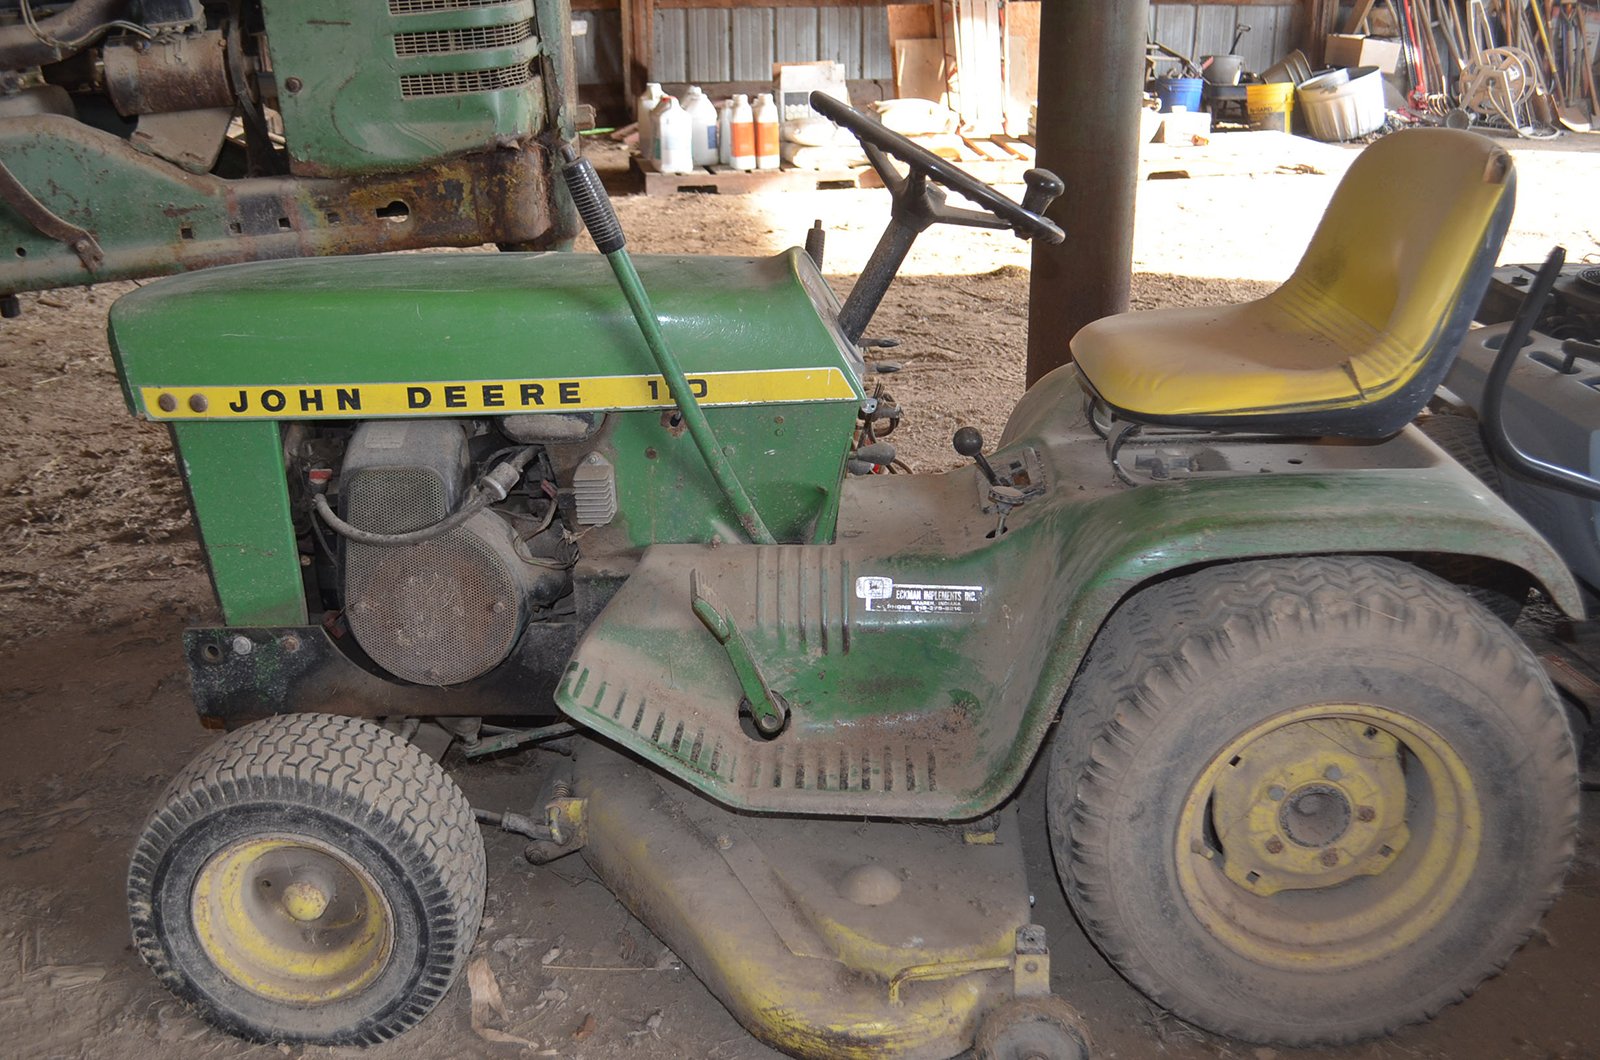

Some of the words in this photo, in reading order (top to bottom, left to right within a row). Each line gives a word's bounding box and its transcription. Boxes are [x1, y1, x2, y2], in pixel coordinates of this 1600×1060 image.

[229, 388, 361, 413] JOHN
[406, 382, 581, 409] DEERE
[923, 590, 962, 602] IMPLEMENTS
